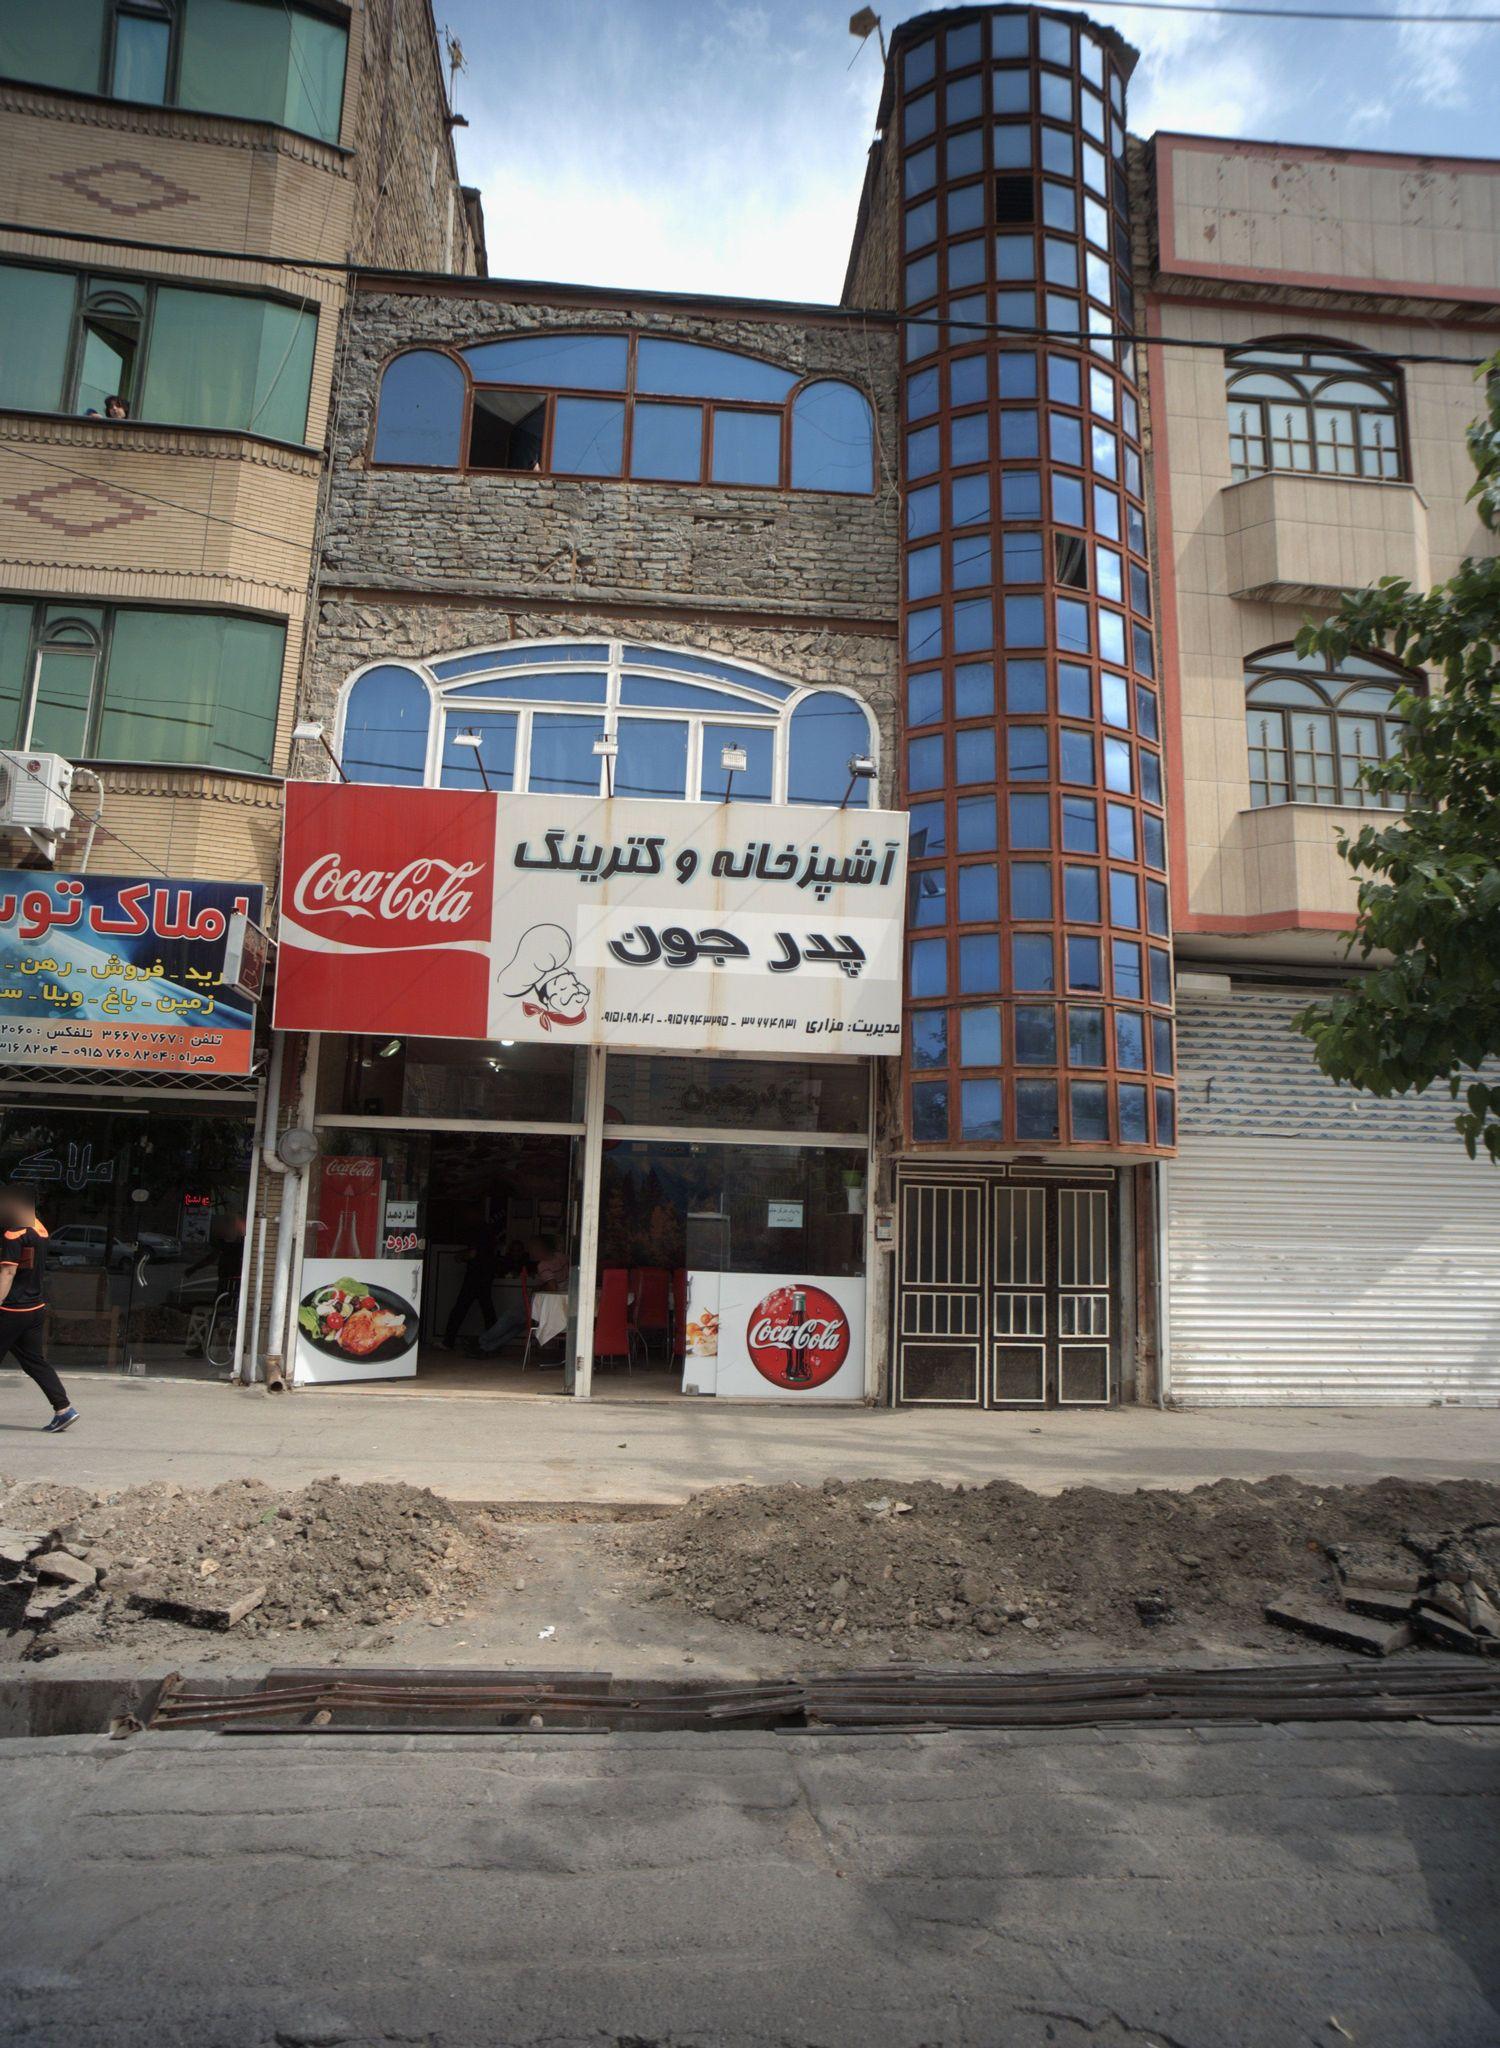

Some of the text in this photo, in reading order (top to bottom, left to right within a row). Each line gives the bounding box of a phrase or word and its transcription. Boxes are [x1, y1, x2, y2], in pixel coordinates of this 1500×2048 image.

[513, 828, 900, 901] آشپزخانه و کترینگ
[294, 853, 487, 923] Coca-Cola
[608, 924, 867, 978] پدر جون
[20, 957, 73, 977] رهن
[91, 954, 165, 981] فروش
[42, 984, 84, 1007] ویلا
[101, 987, 137, 1014] باغ
[156, 994, 215, 1015] زمین
[805, 1018, 844, 1034] مزاری
[386, 1232, 418, 1253] ورود
[749, 1318, 844, 1350] Coca-Cola
